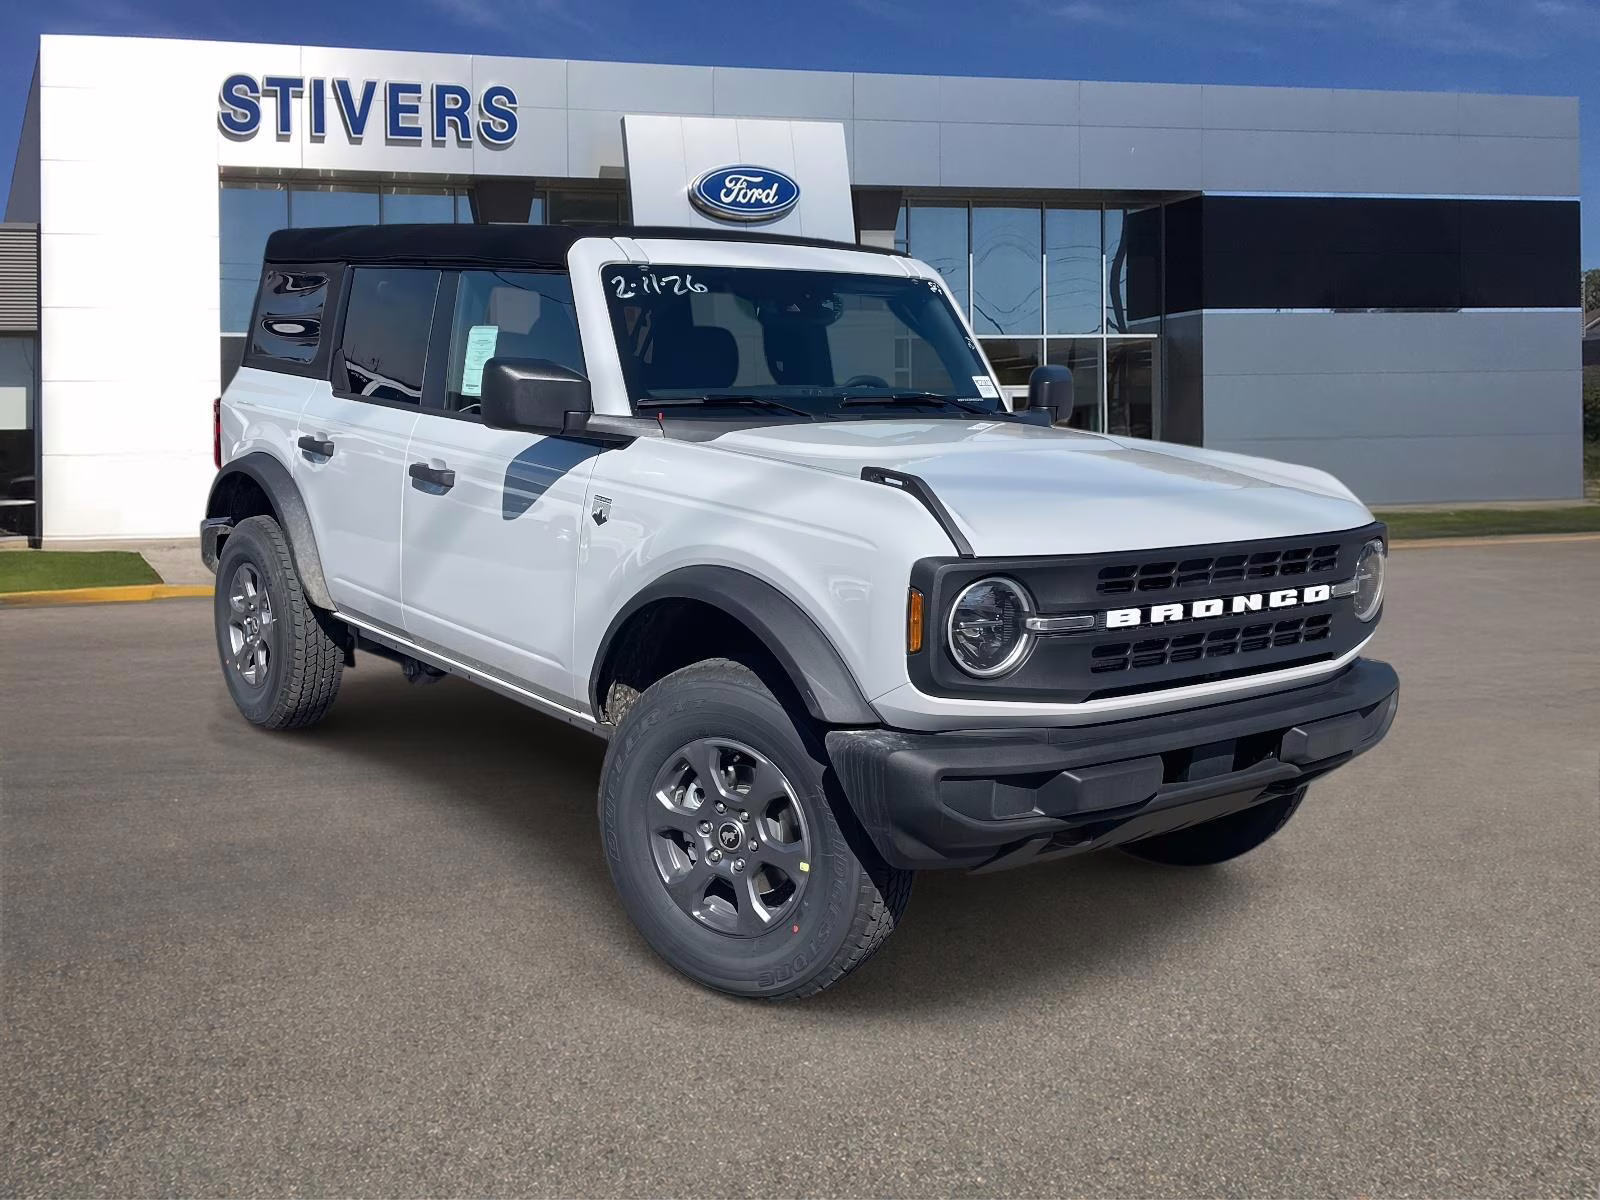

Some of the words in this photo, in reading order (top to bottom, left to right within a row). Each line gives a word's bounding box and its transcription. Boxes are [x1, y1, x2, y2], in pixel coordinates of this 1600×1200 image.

[217, 73, 520, 144] STIVERS
[720, 174, 779, 204] Ford
[1105, 584, 1331, 629] BRONCO
